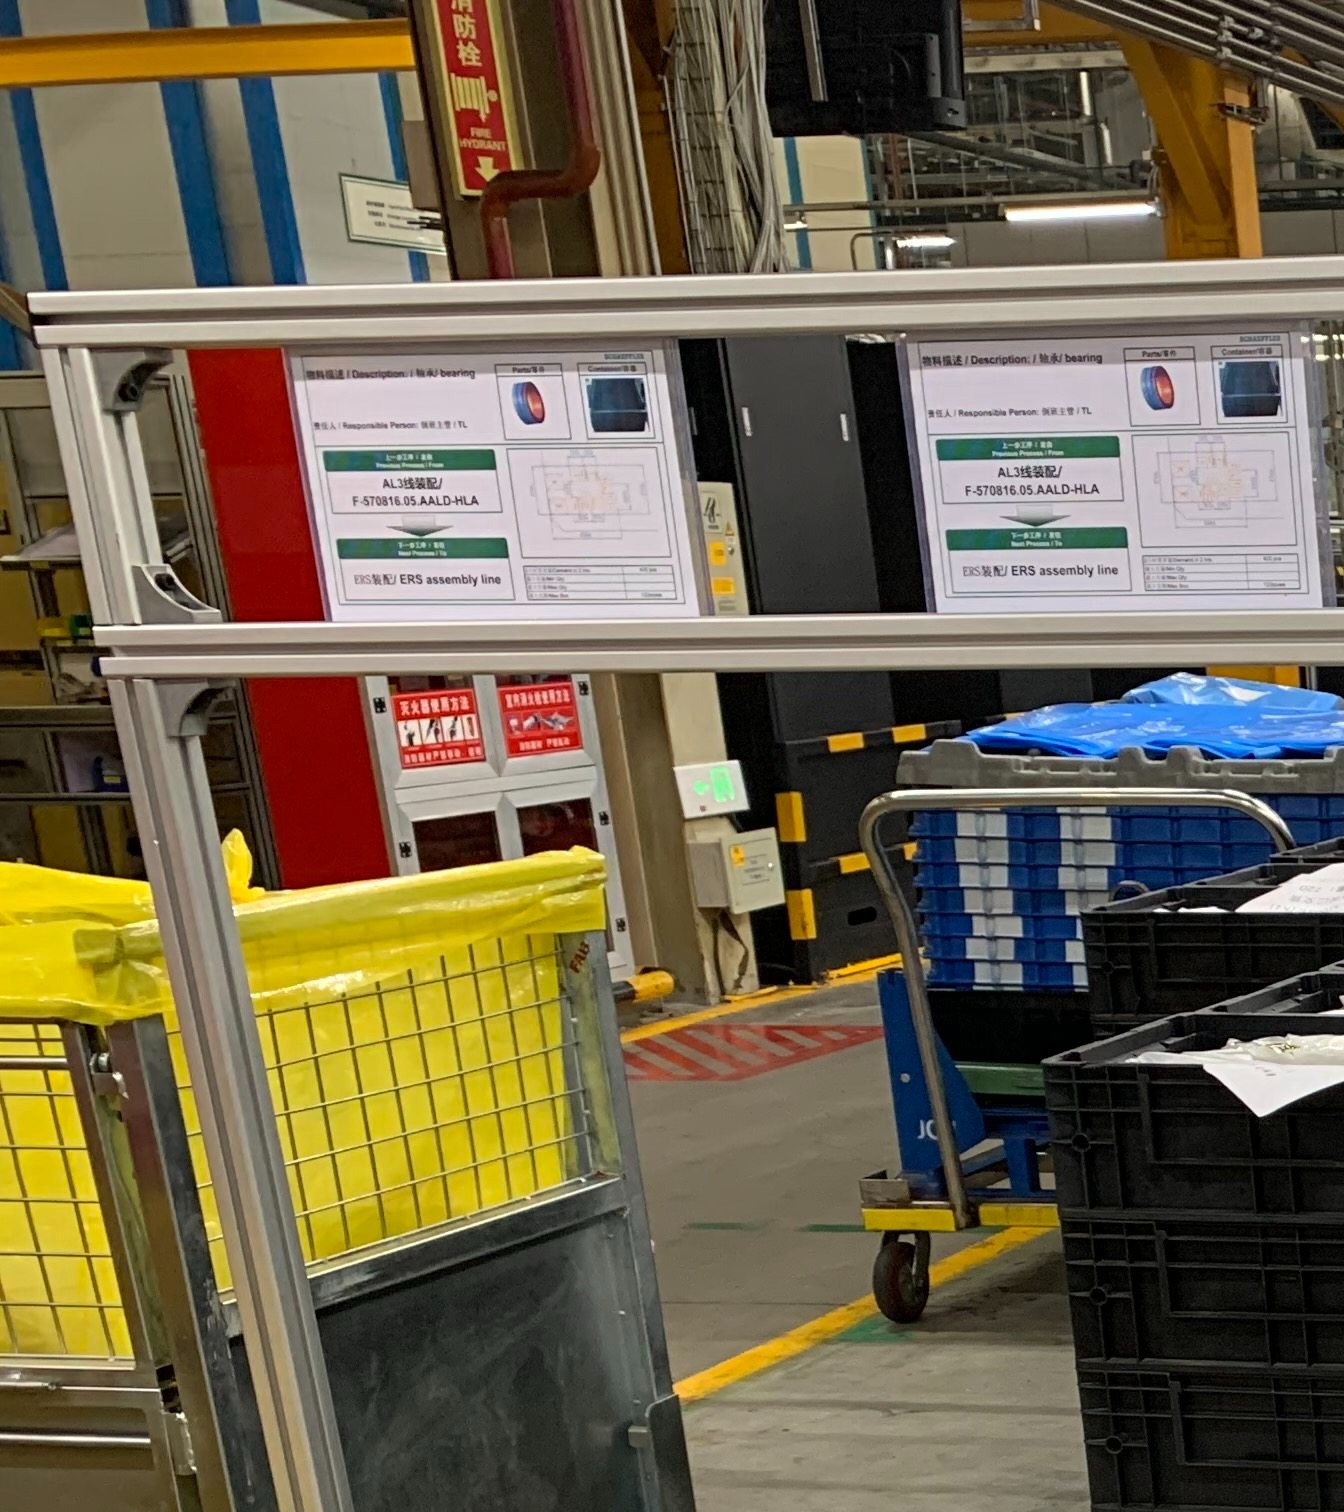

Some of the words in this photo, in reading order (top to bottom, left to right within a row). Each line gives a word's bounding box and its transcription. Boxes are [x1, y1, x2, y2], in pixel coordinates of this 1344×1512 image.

[471, 127, 492, 139] FIRE
[460, 138, 507, 151] HYDRANT
[1065, 353, 1103, 364] bearing
[440, 368, 476, 380] bearing
[958, 409, 1007, 418] Responsible
[1081, 407, 1092, 415] TL
[342, 421, 389, 431] Responsible
[457, 421, 468, 429] TL
[998, 465, 1062, 478] AL3线装配/
[382, 477, 443, 490] AL3线装配/
[965, 483, 1100, 496] F-570816.05.AALD-HLA
[352, 495, 480, 507] F-570816.05.AALD-HLA
[963, 565, 1007, 577] ERS装配/
[1011, 565, 1036, 576] ERS
[1039, 564, 1094, 578] assembly
[1097, 564, 1118, 575] line
[354, 574, 397, 586] ERS装配/
[399, 574, 423, 585] ERS
[426, 574, 478, 587] assembly
[481, 574, 502, 585] line
[399, 696, 470, 716] 灭火器使用方法
